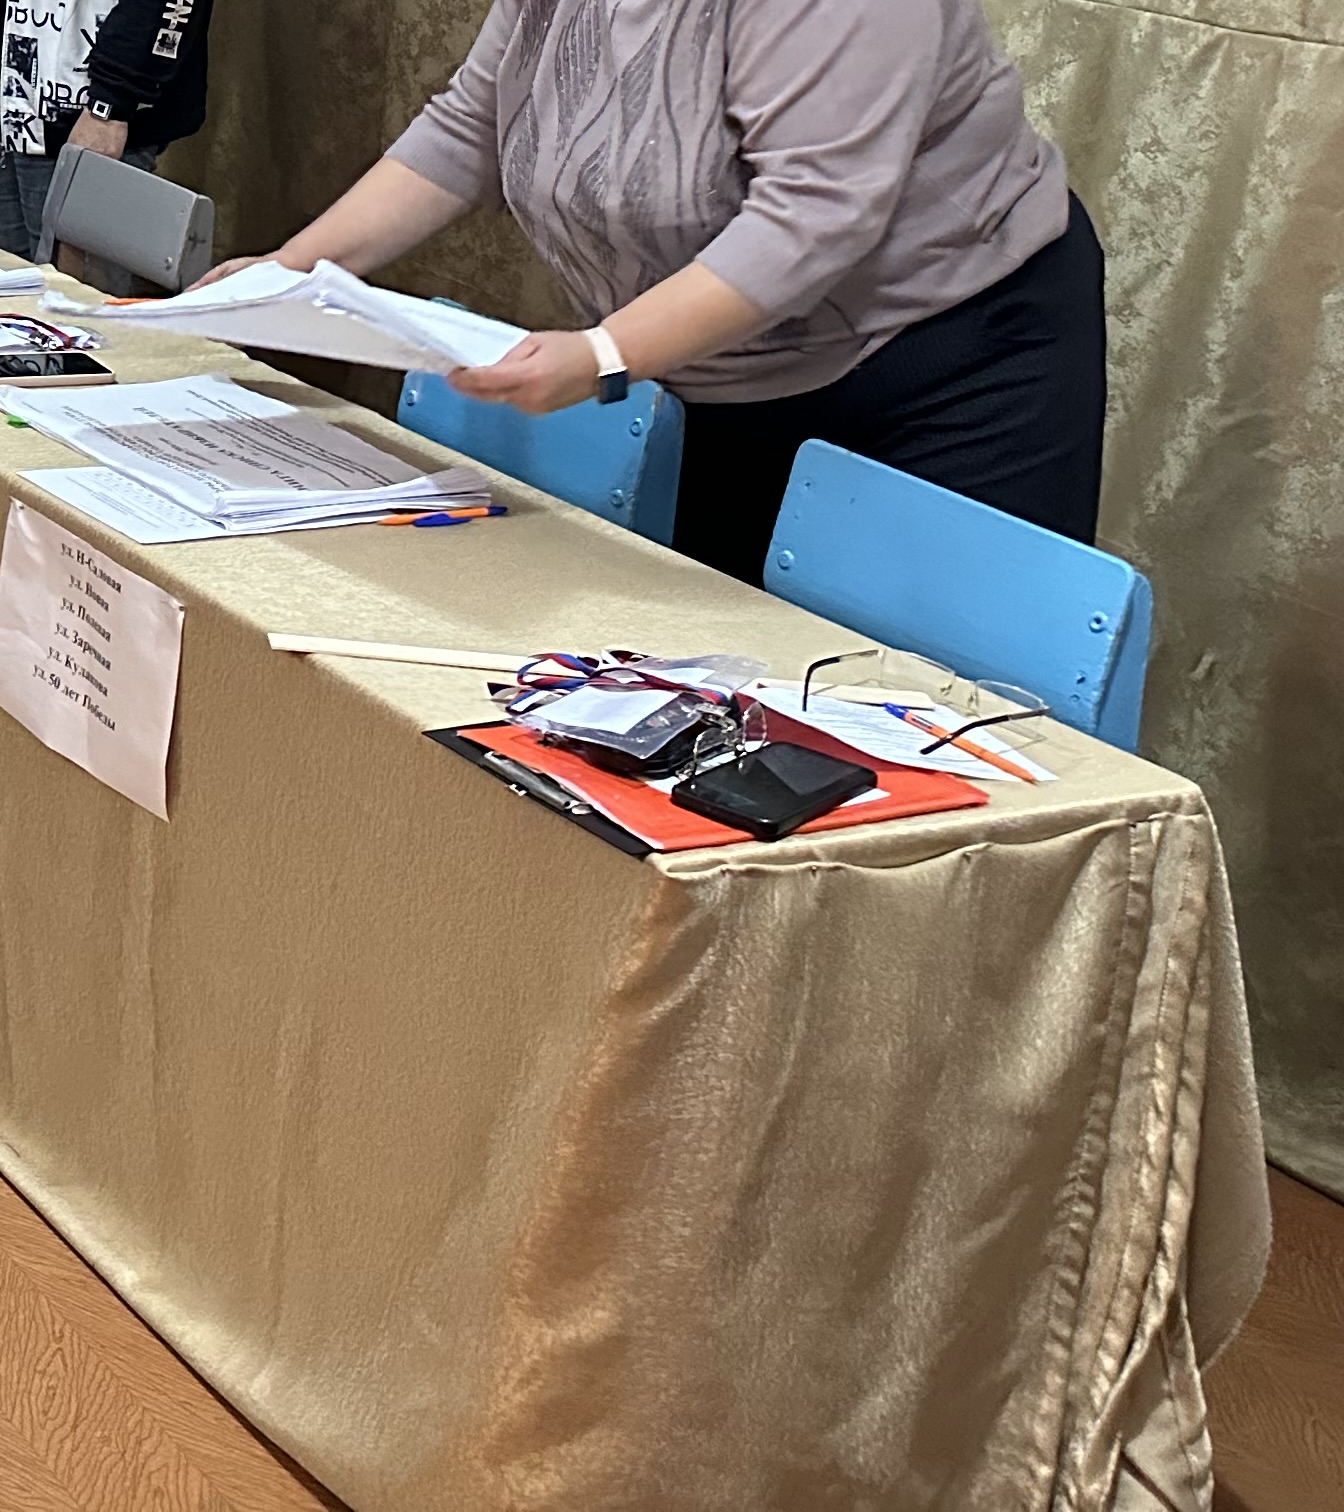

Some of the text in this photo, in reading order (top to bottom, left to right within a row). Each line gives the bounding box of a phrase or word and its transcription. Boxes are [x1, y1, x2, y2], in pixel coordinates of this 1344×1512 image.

[61, 542, 74, 559] ул.
[69, 574, 83, 591] ул.
[60, 597, 75, 614] ул.
[47, 646, 62, 663] ул.
[54, 623, 111, 671] ул. Заречная
[32, 664, 116, 732] ул. 50 лет Победы
